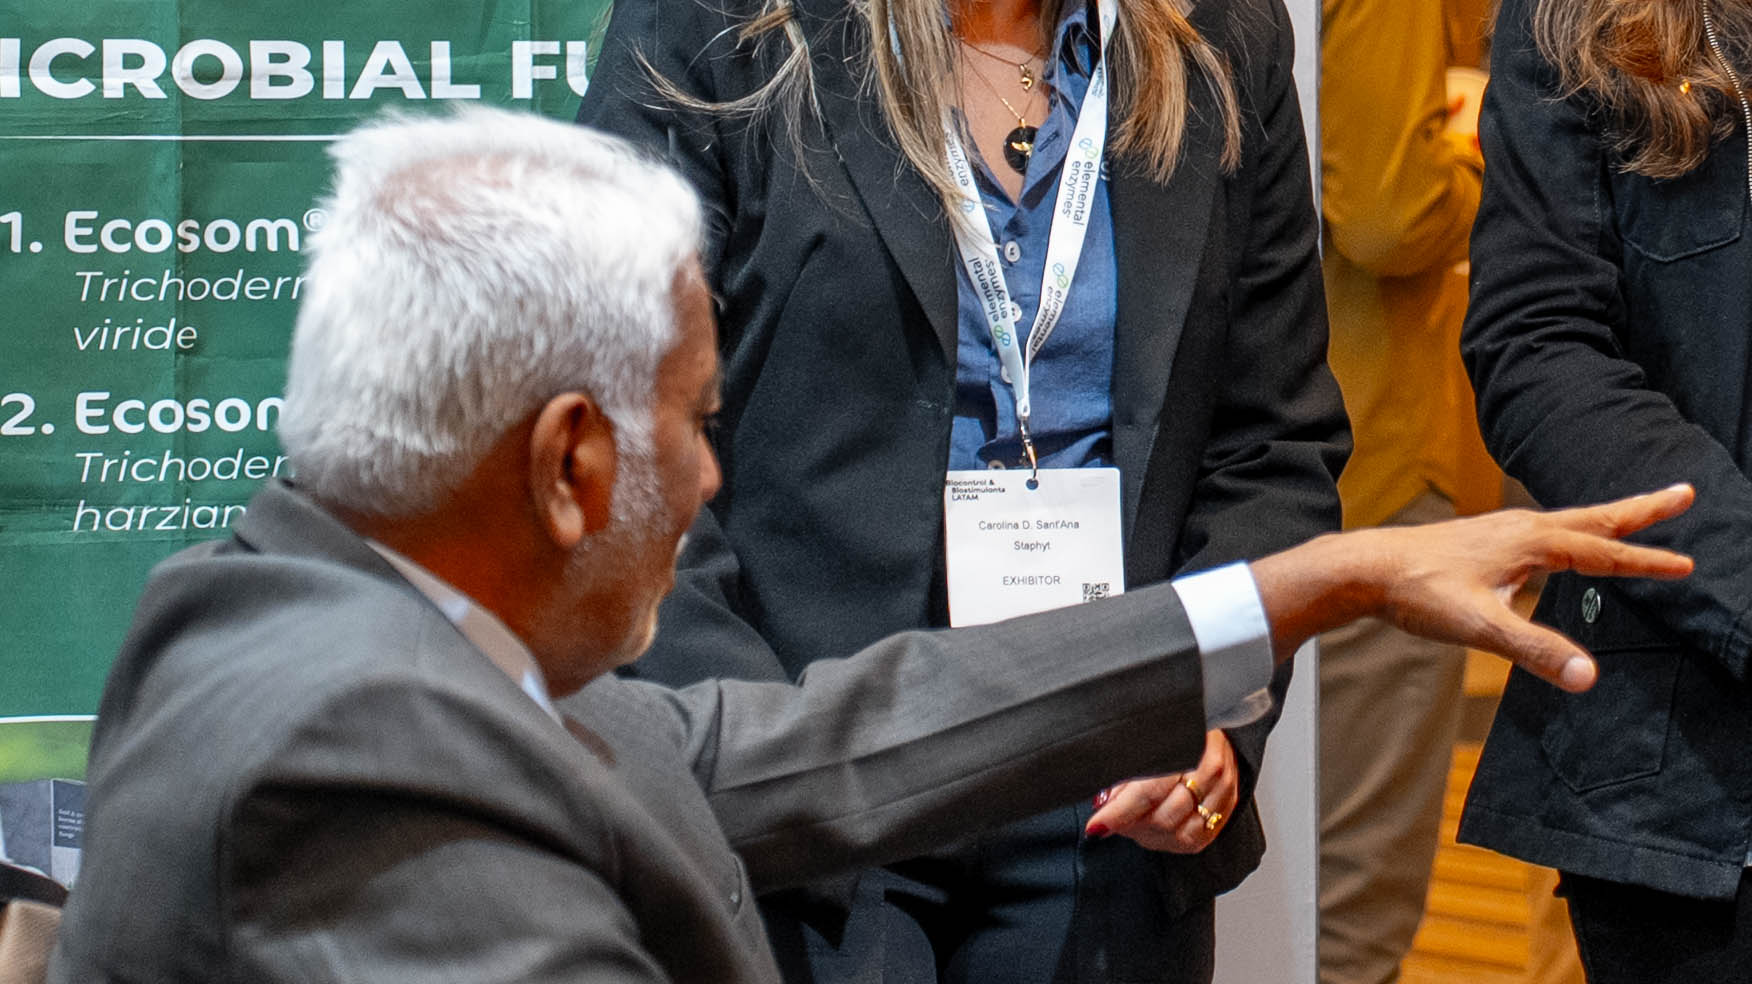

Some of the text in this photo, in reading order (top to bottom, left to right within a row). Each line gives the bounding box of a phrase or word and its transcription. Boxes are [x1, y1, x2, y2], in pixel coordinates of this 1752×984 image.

[1073, 161, 1093, 226] elemental
[0, 211, 42, 253] 1.
[968, 257, 1000, 322] elemental
[73, 318, 198, 351] viride
[1031, 289, 1062, 353] elemental
[0, 393, 54, 436] 2.
[76, 448, 290, 483] Trichoder
[979, 520, 1079, 530] Carolina D. Sant'Ana
[1014, 541, 1051, 552] Staphyt
[1002, 575, 1060, 586] EXHIBITOR
